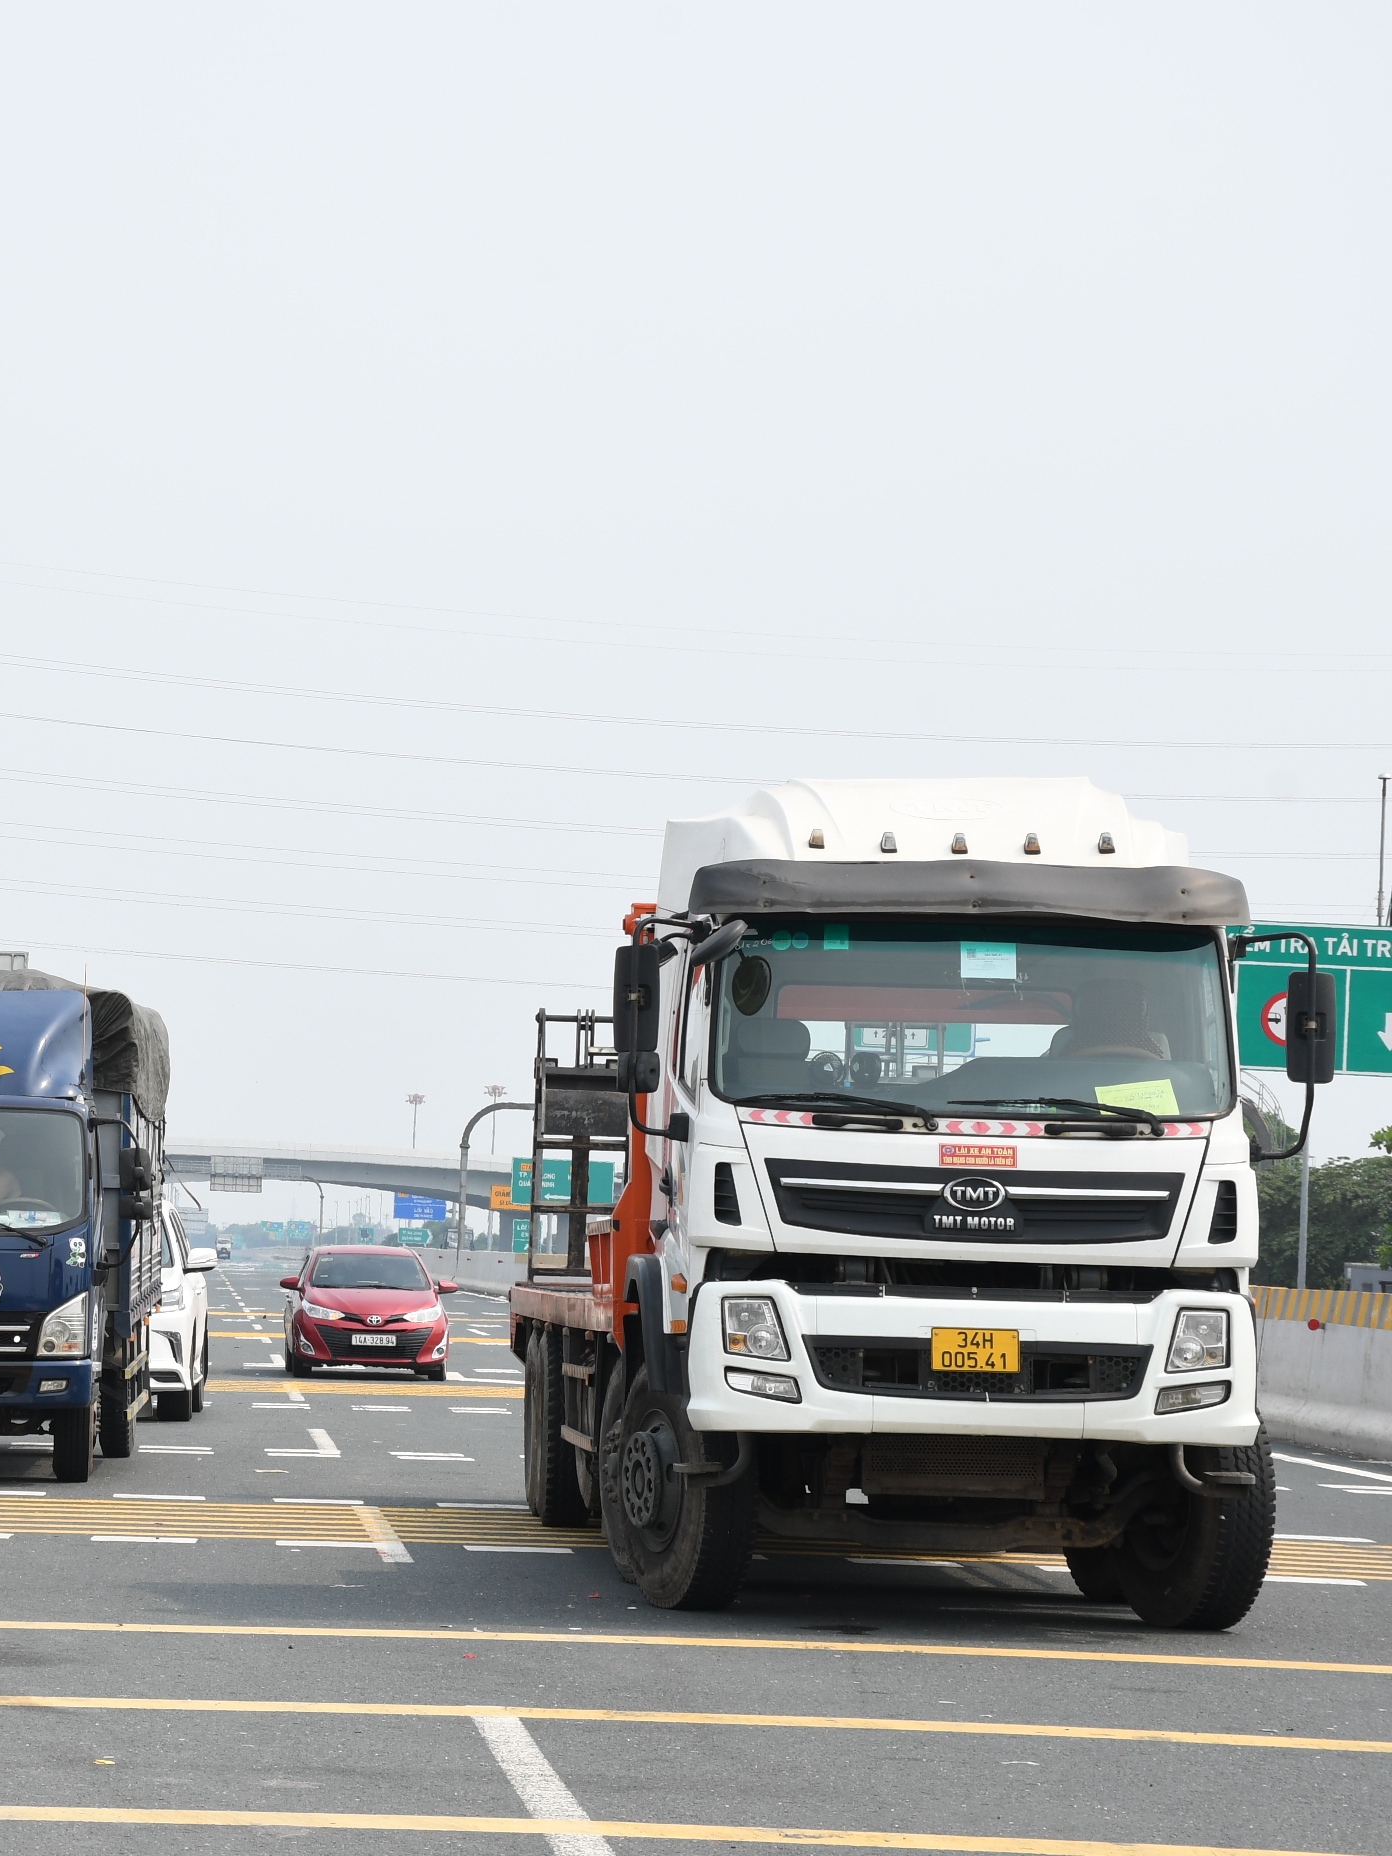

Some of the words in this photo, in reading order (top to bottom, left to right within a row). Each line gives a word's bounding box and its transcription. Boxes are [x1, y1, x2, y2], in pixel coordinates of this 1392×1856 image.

[1324, 932, 1358, 957] TẢI
[956, 1145, 968, 1154] LÁI
[993, 1146, 1013, 1155] TOÀN
[952, 1186, 997, 1202] TMT
[933, 1215, 963, 1228] TMT
[967, 1216, 1015, 1231] MOTOR
[957, 1331, 994, 1349] 34H
[941, 1351, 1007, 1370] 005.41
